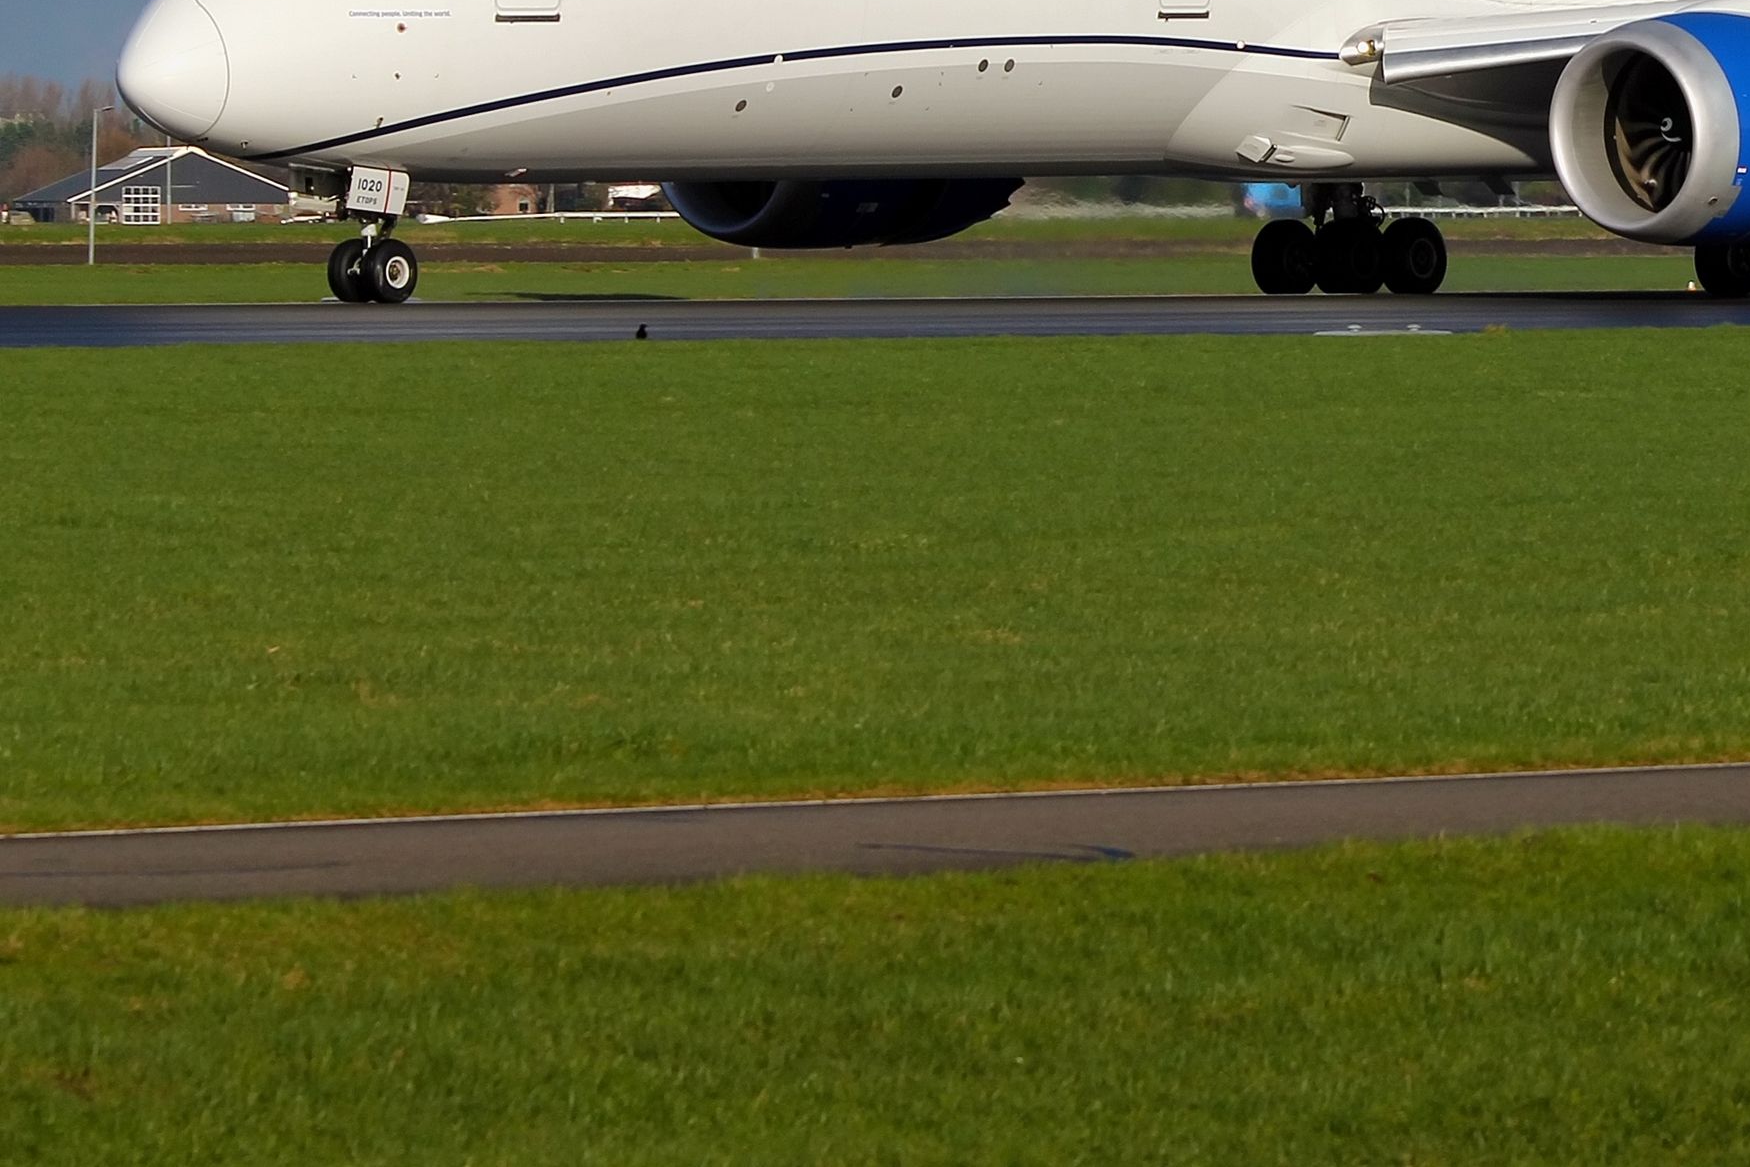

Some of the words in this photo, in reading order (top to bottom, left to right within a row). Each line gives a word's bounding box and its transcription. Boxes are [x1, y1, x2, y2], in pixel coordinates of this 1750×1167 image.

[349, 10, 380, 18] Connecting
[357, 178, 383, 193] 1020
[356, 195, 377, 205] ETOPS
